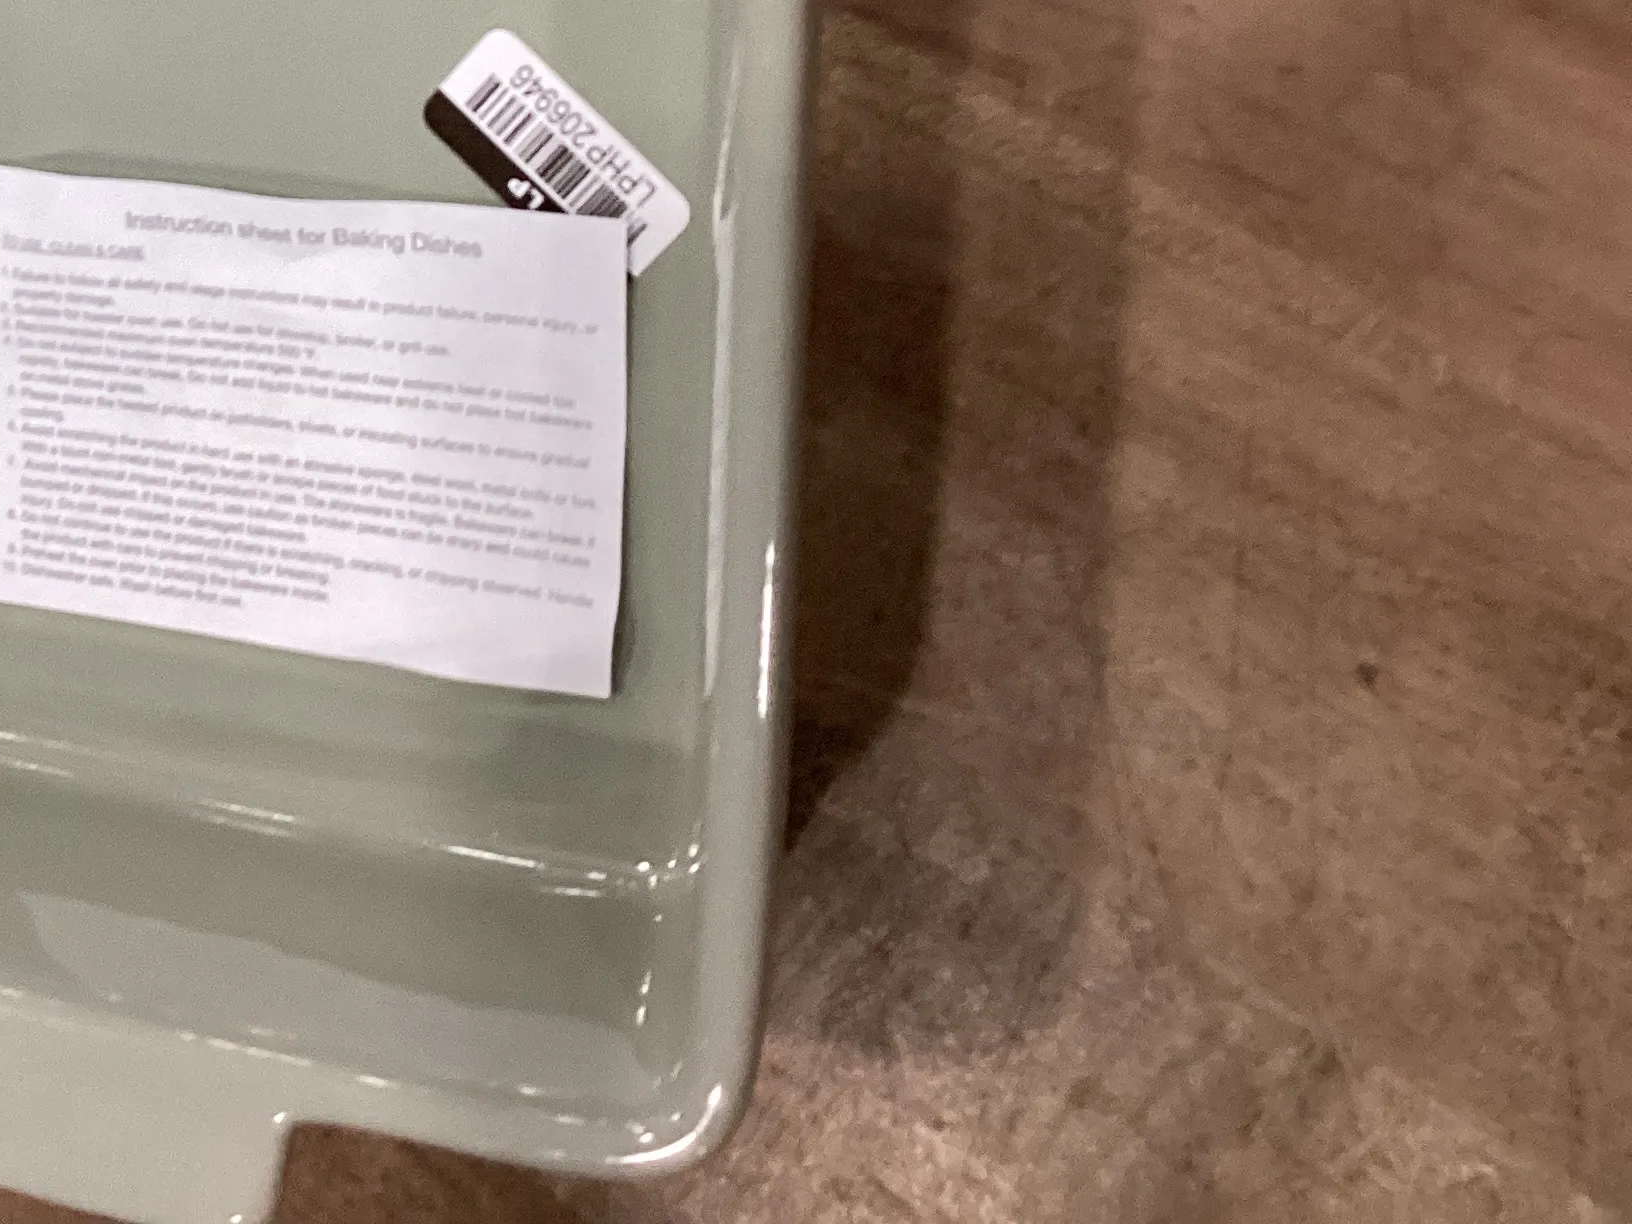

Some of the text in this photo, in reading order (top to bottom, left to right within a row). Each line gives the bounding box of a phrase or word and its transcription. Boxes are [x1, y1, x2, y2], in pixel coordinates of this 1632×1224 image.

[124, 210, 483, 258] Instruction sheet for Baking Dishes
